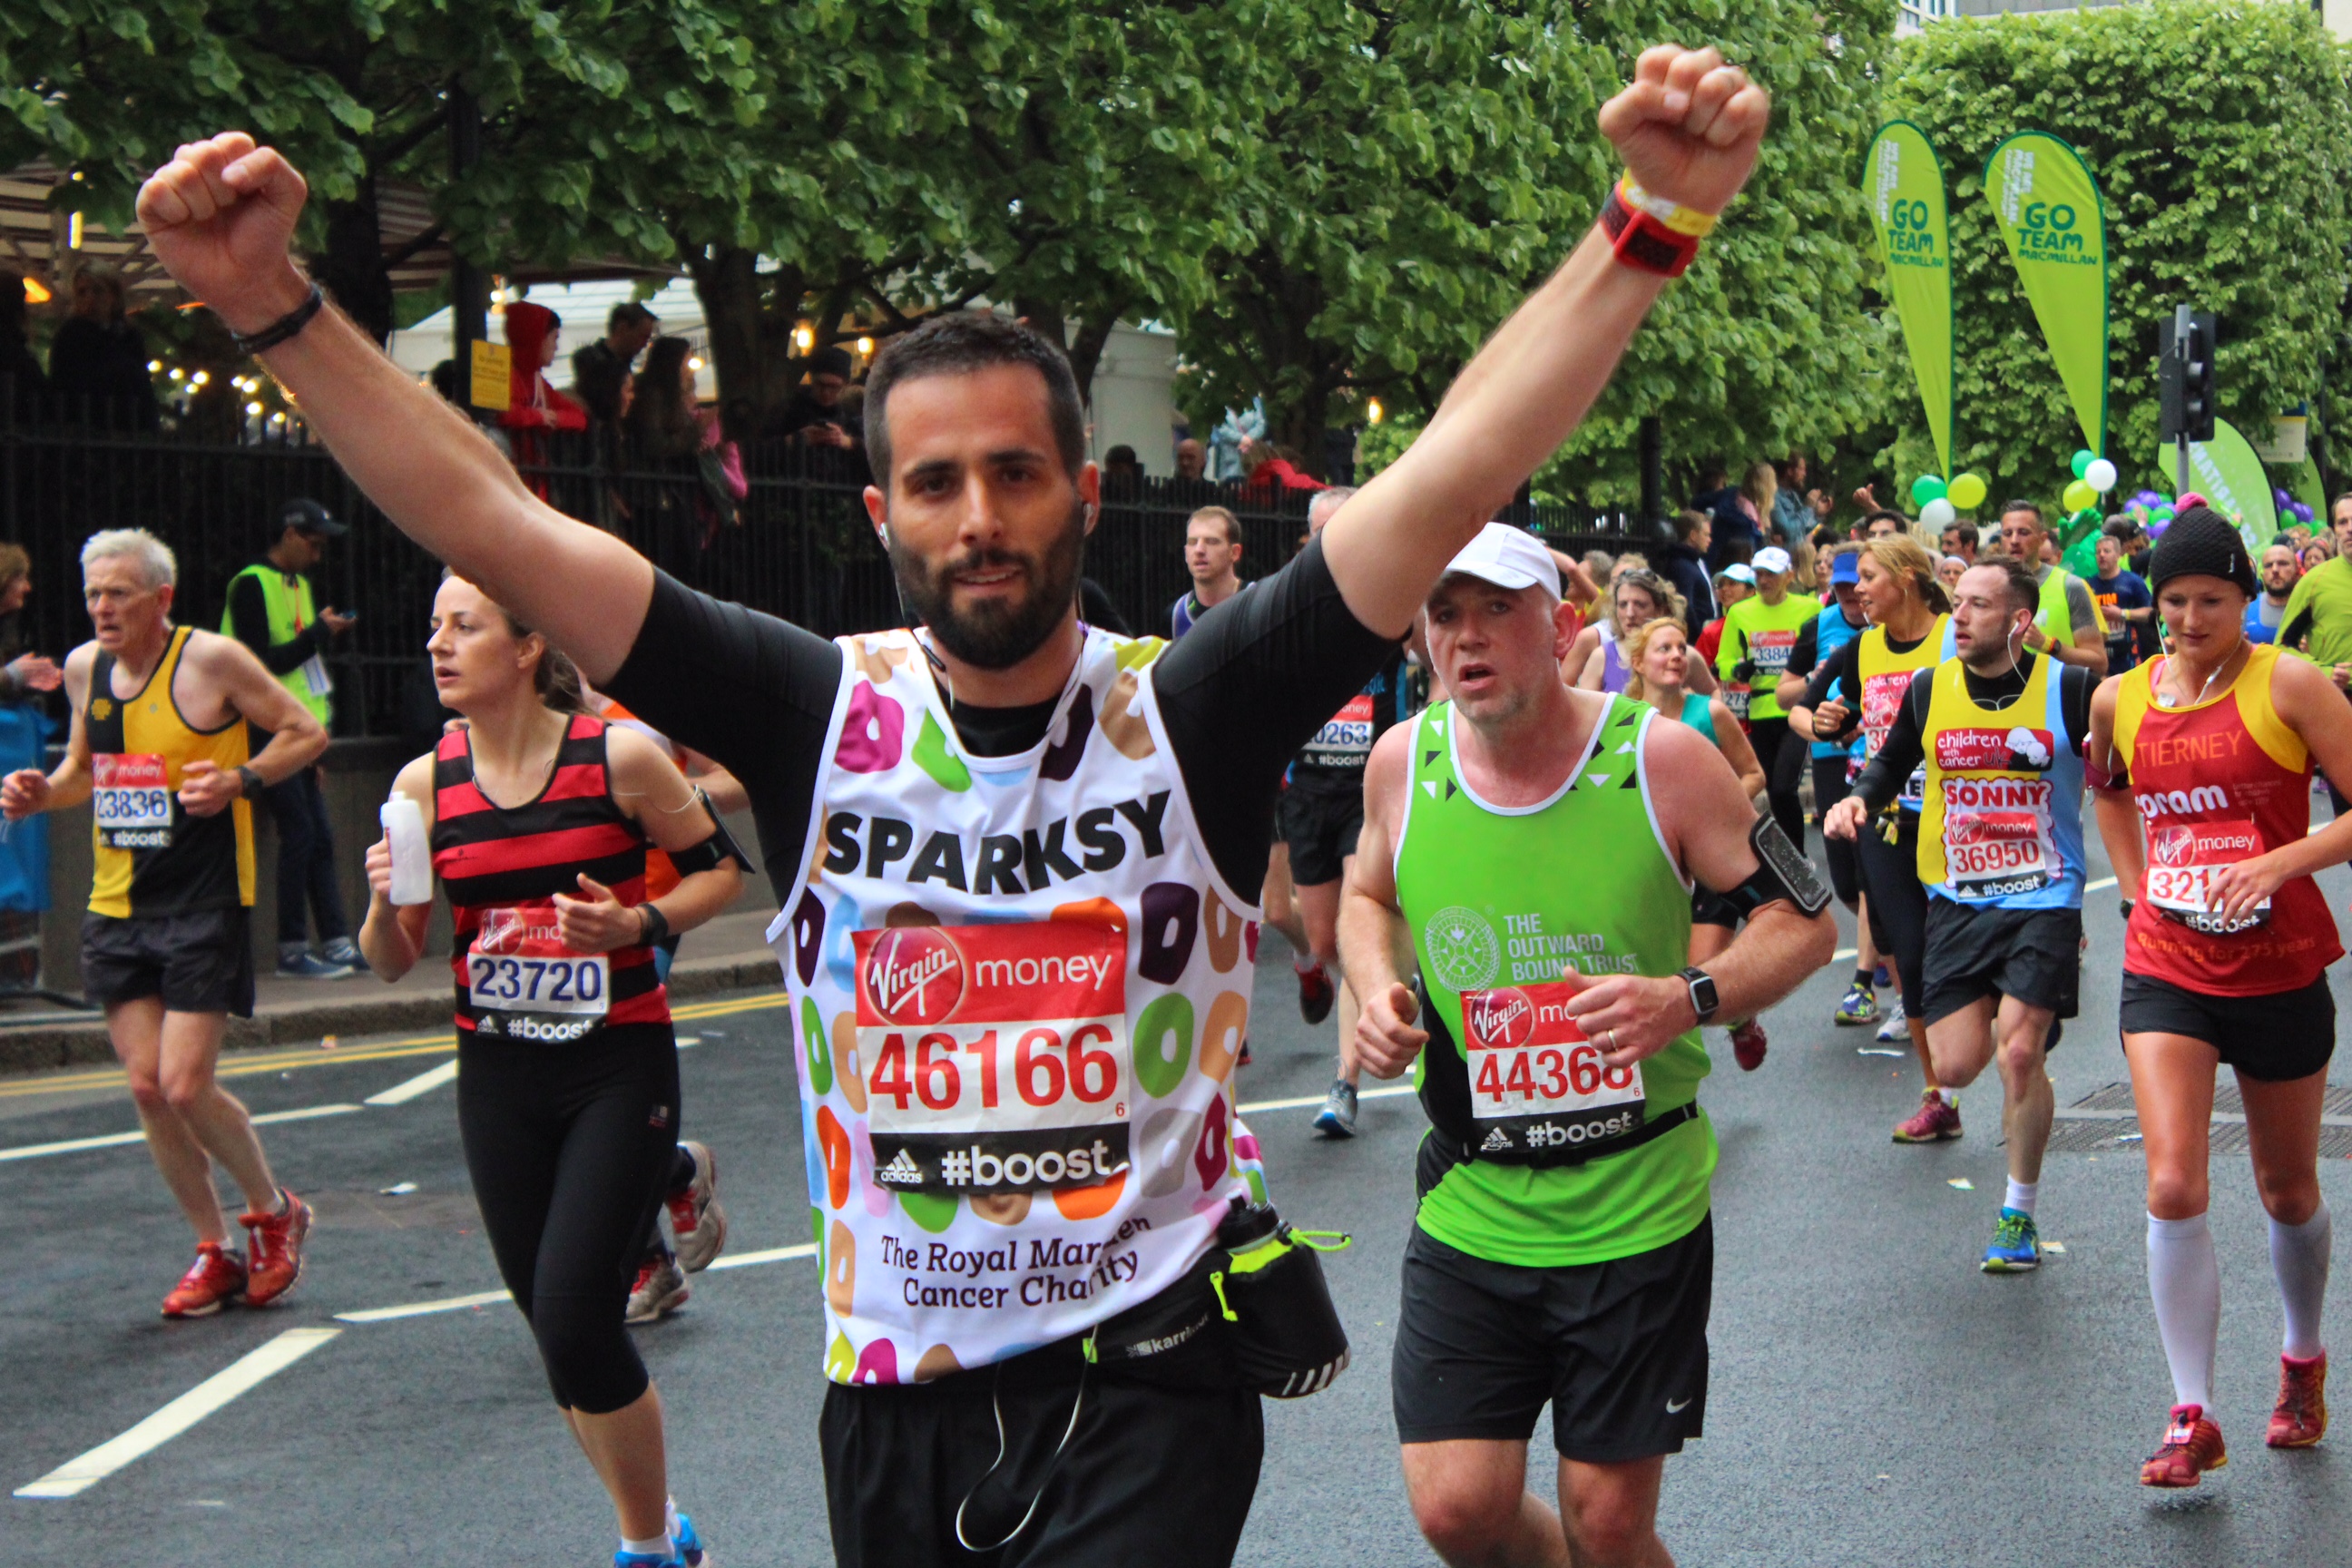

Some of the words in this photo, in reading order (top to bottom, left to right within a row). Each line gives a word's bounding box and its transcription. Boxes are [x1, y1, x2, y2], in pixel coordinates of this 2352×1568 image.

[1892, 199, 1928, 231] GO
[2024, 201, 2076, 231] GO
[1887, 229, 1934, 254] TEAM
[2016, 228, 2083, 252] TEAM
[1889, 252, 1945, 268] MACMILLAN
[2018, 249, 2098, 266] MACMILLAN
[1339, 703, 1369, 716] oney
[1310, 723, 1368, 745] 0263
[1937, 729, 2001, 749] children
[1318, 753, 1366, 766] #boost
[1938, 754, 1981, 768] cancer
[1943, 749, 1960, 758] with
[2136, 730, 2243, 768] TIERNEY
[118, 764, 162, 778] money
[94, 789, 168, 818] 23836
[1945, 785, 2047, 808] SONNY
[113, 829, 166, 847] #boost
[1951, 814, 1984, 842] Virgin
[1985, 820, 2031, 835] money
[822, 789, 1171, 896] SPARKSY
[2157, 828, 2191, 864] Virgin
[2198, 834, 2256, 852] money
[1953, 840, 2039, 874] 36950
[1983, 875, 2041, 897] #boost
[2151, 867, 2230, 904] 321
[482, 910, 520, 952] Virgin
[1503, 913, 1543, 935] THE
[1507, 933, 1604, 959] OUTWARD
[2137, 931, 2204, 964] Running
[472, 958, 602, 1002] 23720
[870, 931, 957, 1017] Virgin
[975, 954, 1112, 991] money
[1511, 956, 1580, 982] BOUND
[1582, 953, 1640, 975] TRUST
[507, 1016, 592, 1040] #boost
[1474, 991, 1528, 1044] Virgin
[868, 1024, 1118, 1111] 46166
[1633, 1087, 1641, 1097] 6
[1114, 1102, 1125, 1117] 6
[1525, 1111, 1632, 1148] #boost
[880, 1170, 923, 1184] adidas
[941, 1140, 1111, 1186] #boost
[881, 1234, 918, 1269] The
[926, 1240, 1017, 1279] Royal
[1028, 1217, 1152, 1270] Maren
[904, 1277, 1009, 1308] Cancer
[1020, 1247, 1139, 1307] Charity
